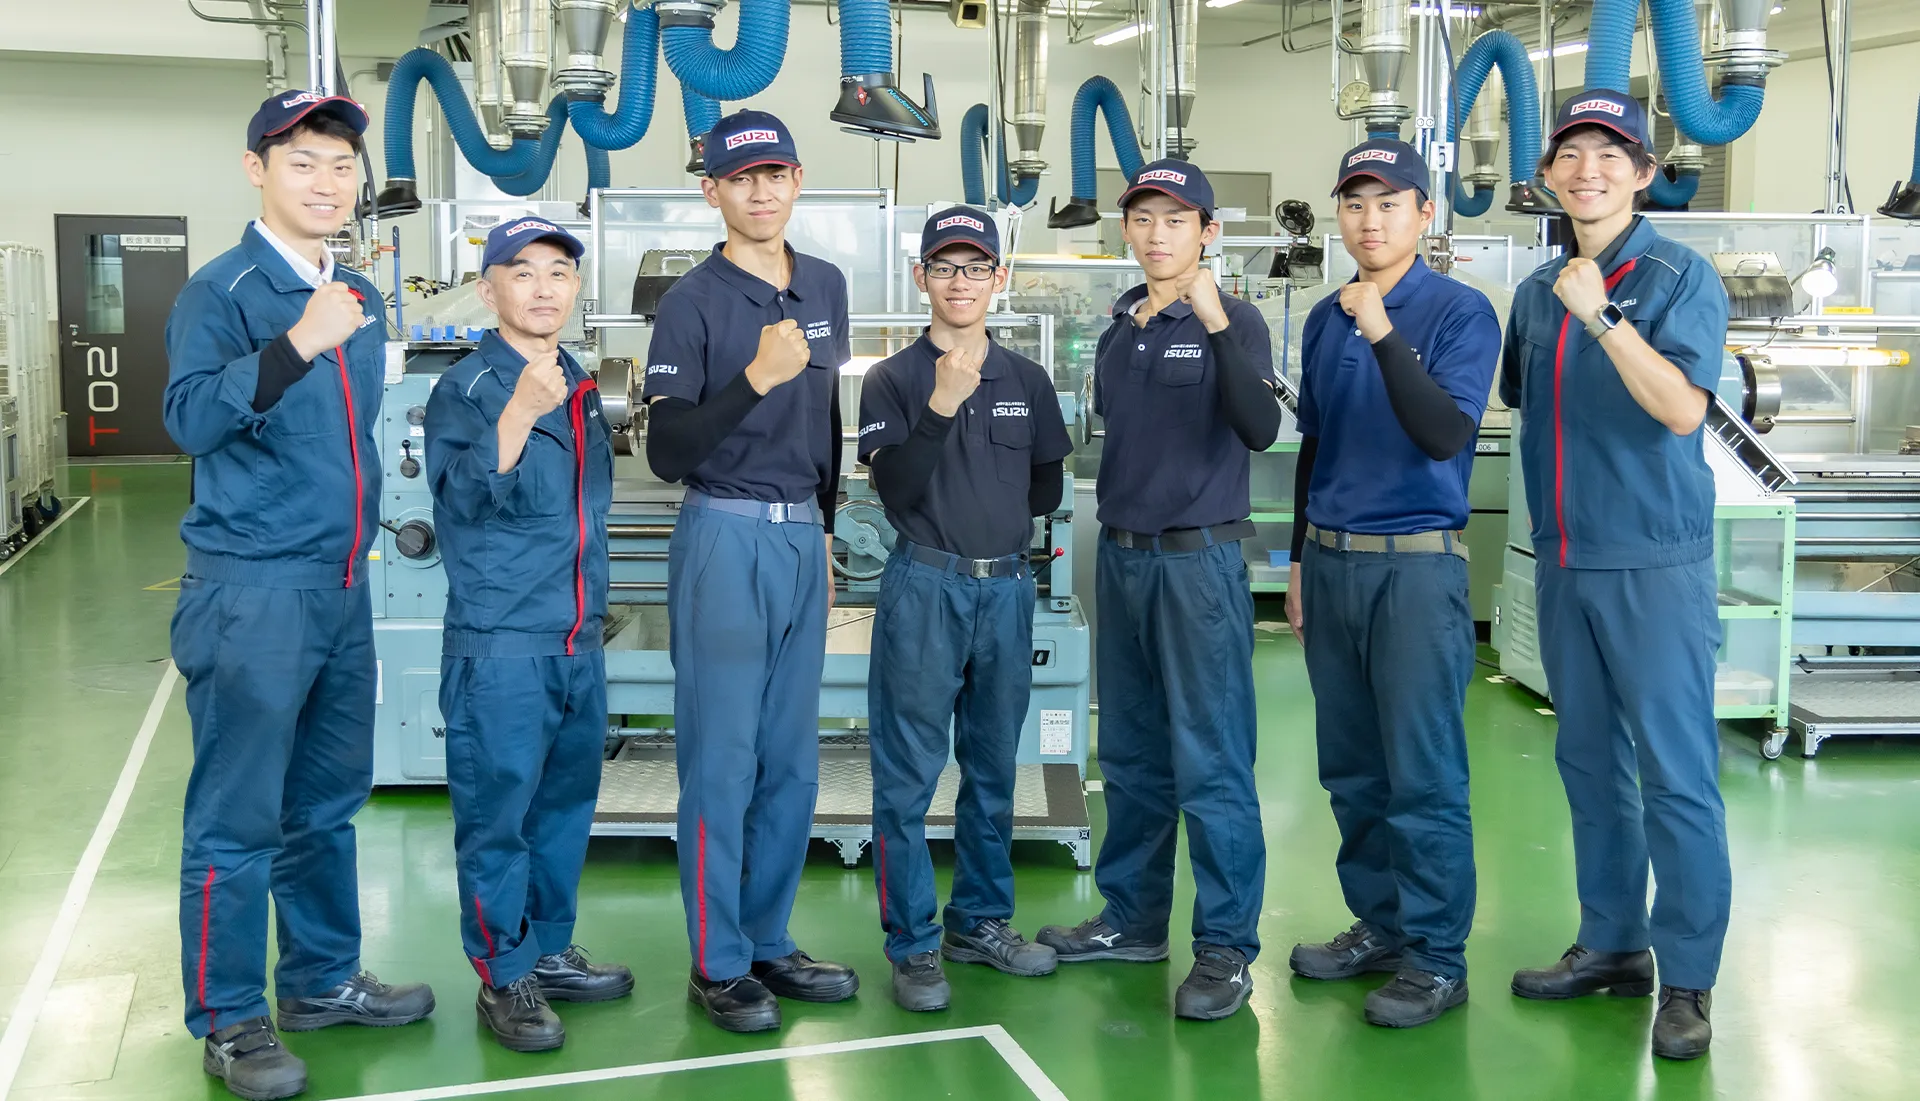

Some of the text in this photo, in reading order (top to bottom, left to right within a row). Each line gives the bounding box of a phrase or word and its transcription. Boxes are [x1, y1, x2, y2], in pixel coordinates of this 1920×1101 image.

[887, 87, 928, 126] Nederman
[1573, 101, 1620, 113] ISUZU
[728, 132, 775, 147] ISUZU
[1350, 152, 1395, 165] ISUZU
[1438, 145, 1446, 168] 5
[1140, 171, 1184, 182] ISUZU
[508, 222, 555, 234] ISUZU
[939, 217, 981, 229] ISUZU
[806, 327, 831, 339] ISUZU
[1164, 349, 1202, 358] ISUZU
[992, 407, 1029, 417] ISUZU
[858, 421, 886, 437] SUZU
